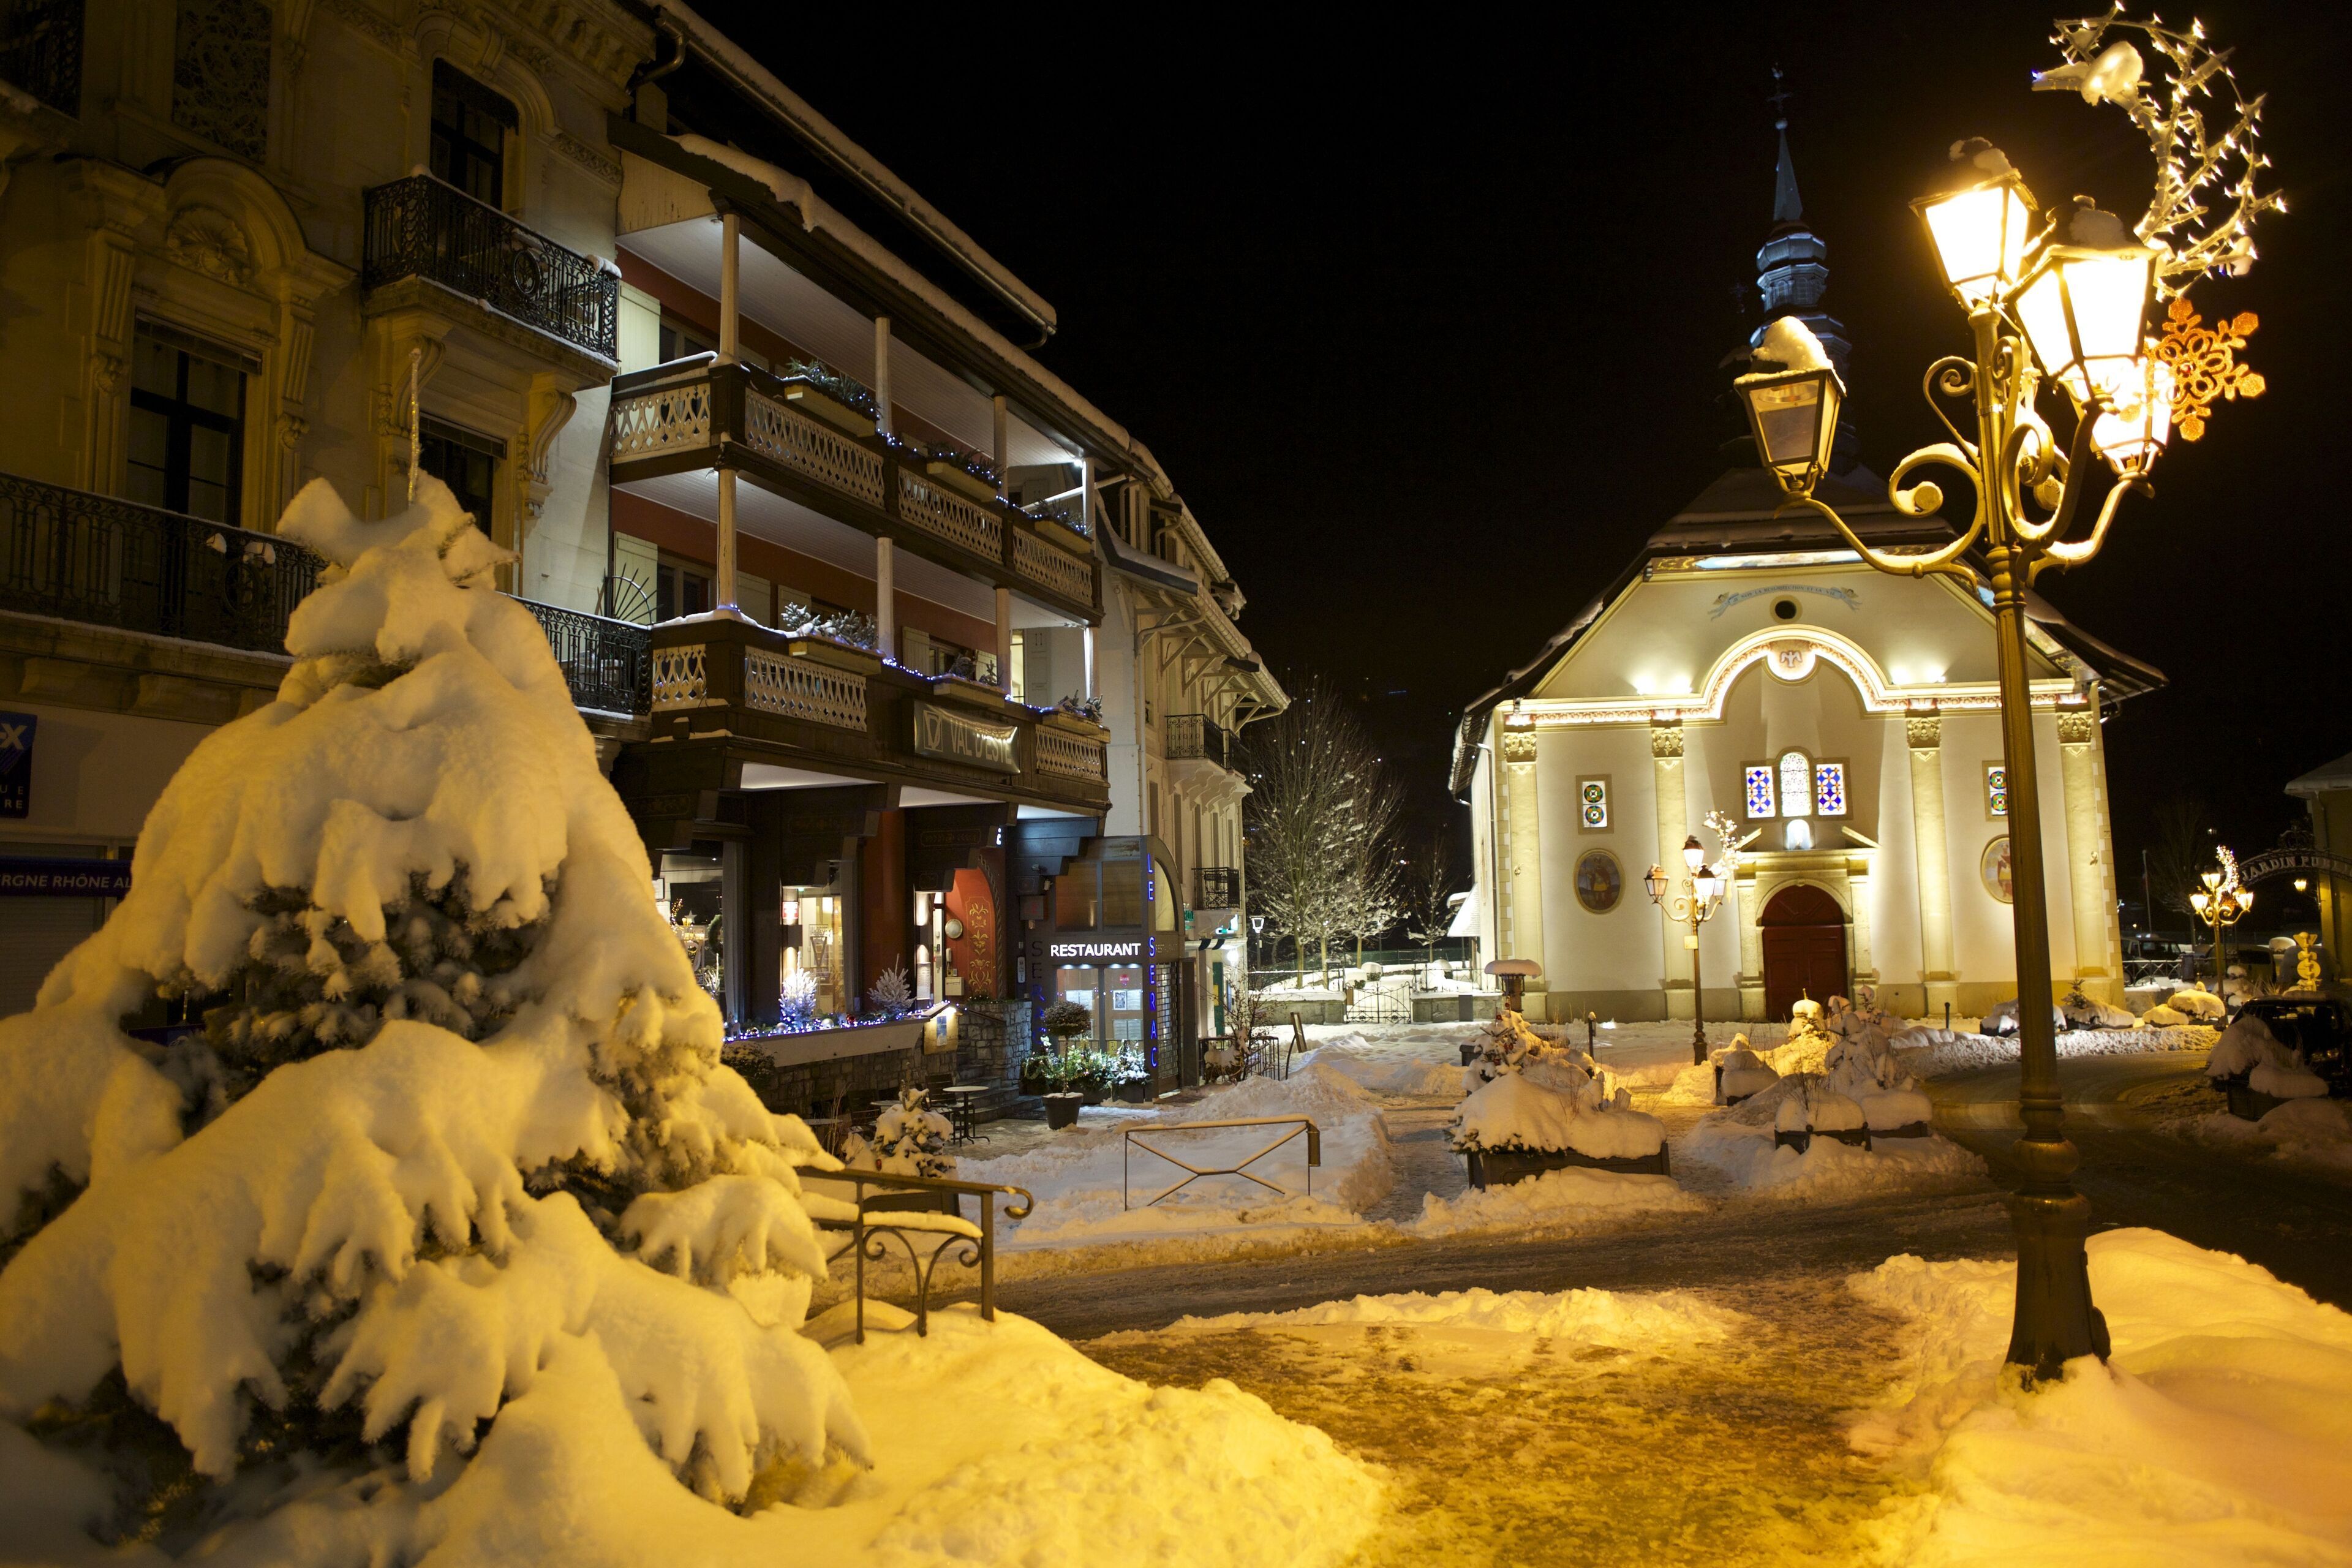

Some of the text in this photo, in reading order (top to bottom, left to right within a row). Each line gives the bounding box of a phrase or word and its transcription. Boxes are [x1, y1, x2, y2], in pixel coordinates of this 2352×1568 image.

[950, 718, 973, 756] VAL
[0, 875, 49, 888] RGNE
[53, 873, 111, 888] RHÔNE
[2242, 856, 2296, 881] JARDIN
[1050, 943, 1142, 957] RESTAURANT
[1147, 853, 1158, 1069] LE SERAC
